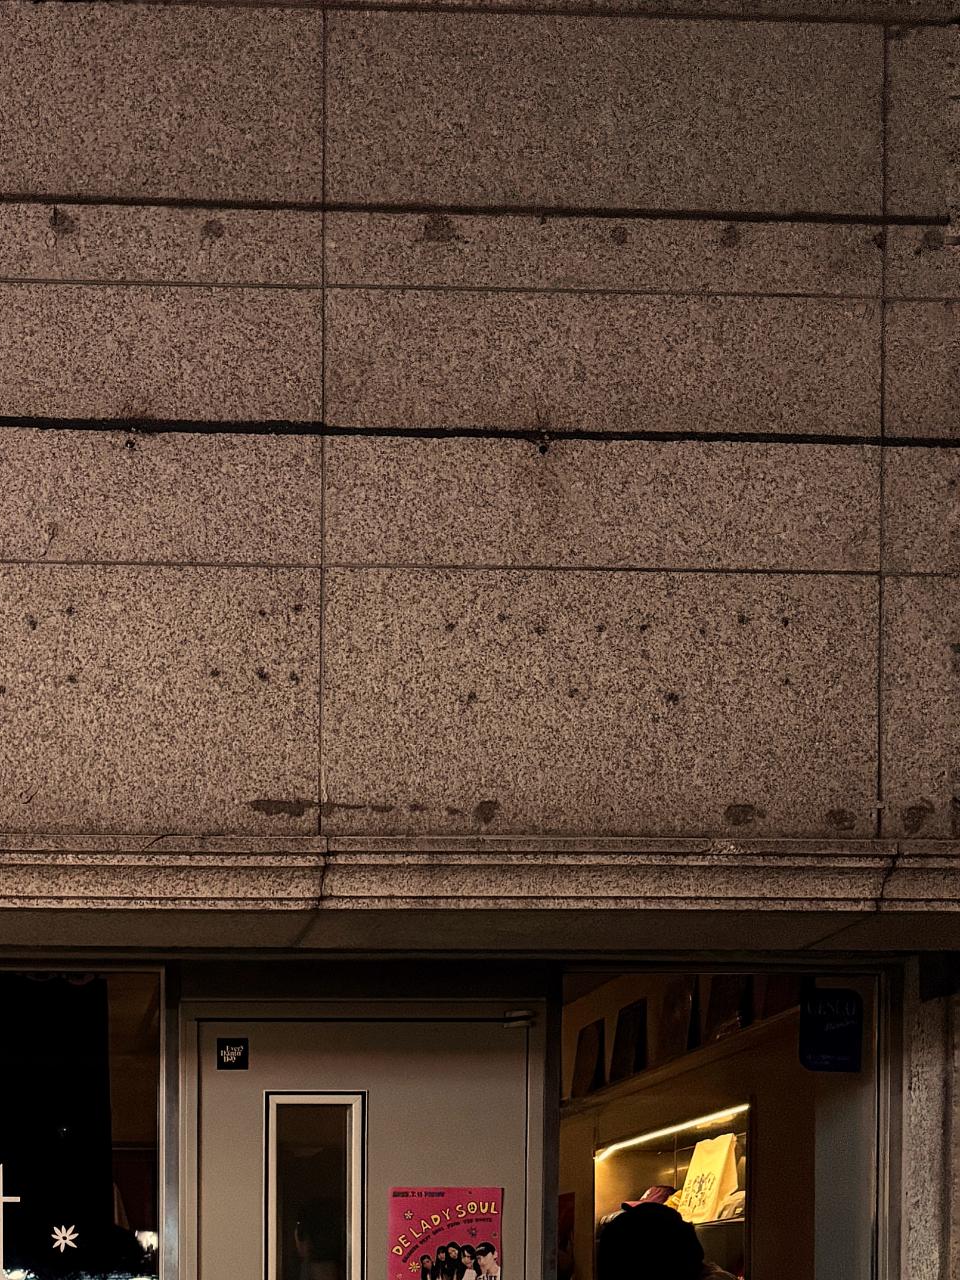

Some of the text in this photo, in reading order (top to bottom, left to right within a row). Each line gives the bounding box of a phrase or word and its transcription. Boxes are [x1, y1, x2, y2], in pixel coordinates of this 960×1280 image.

[392, 1234, 411, 1256] DE
[409, 1208, 450, 1238] LADY
[456, 1201, 498, 1218] SOUL
